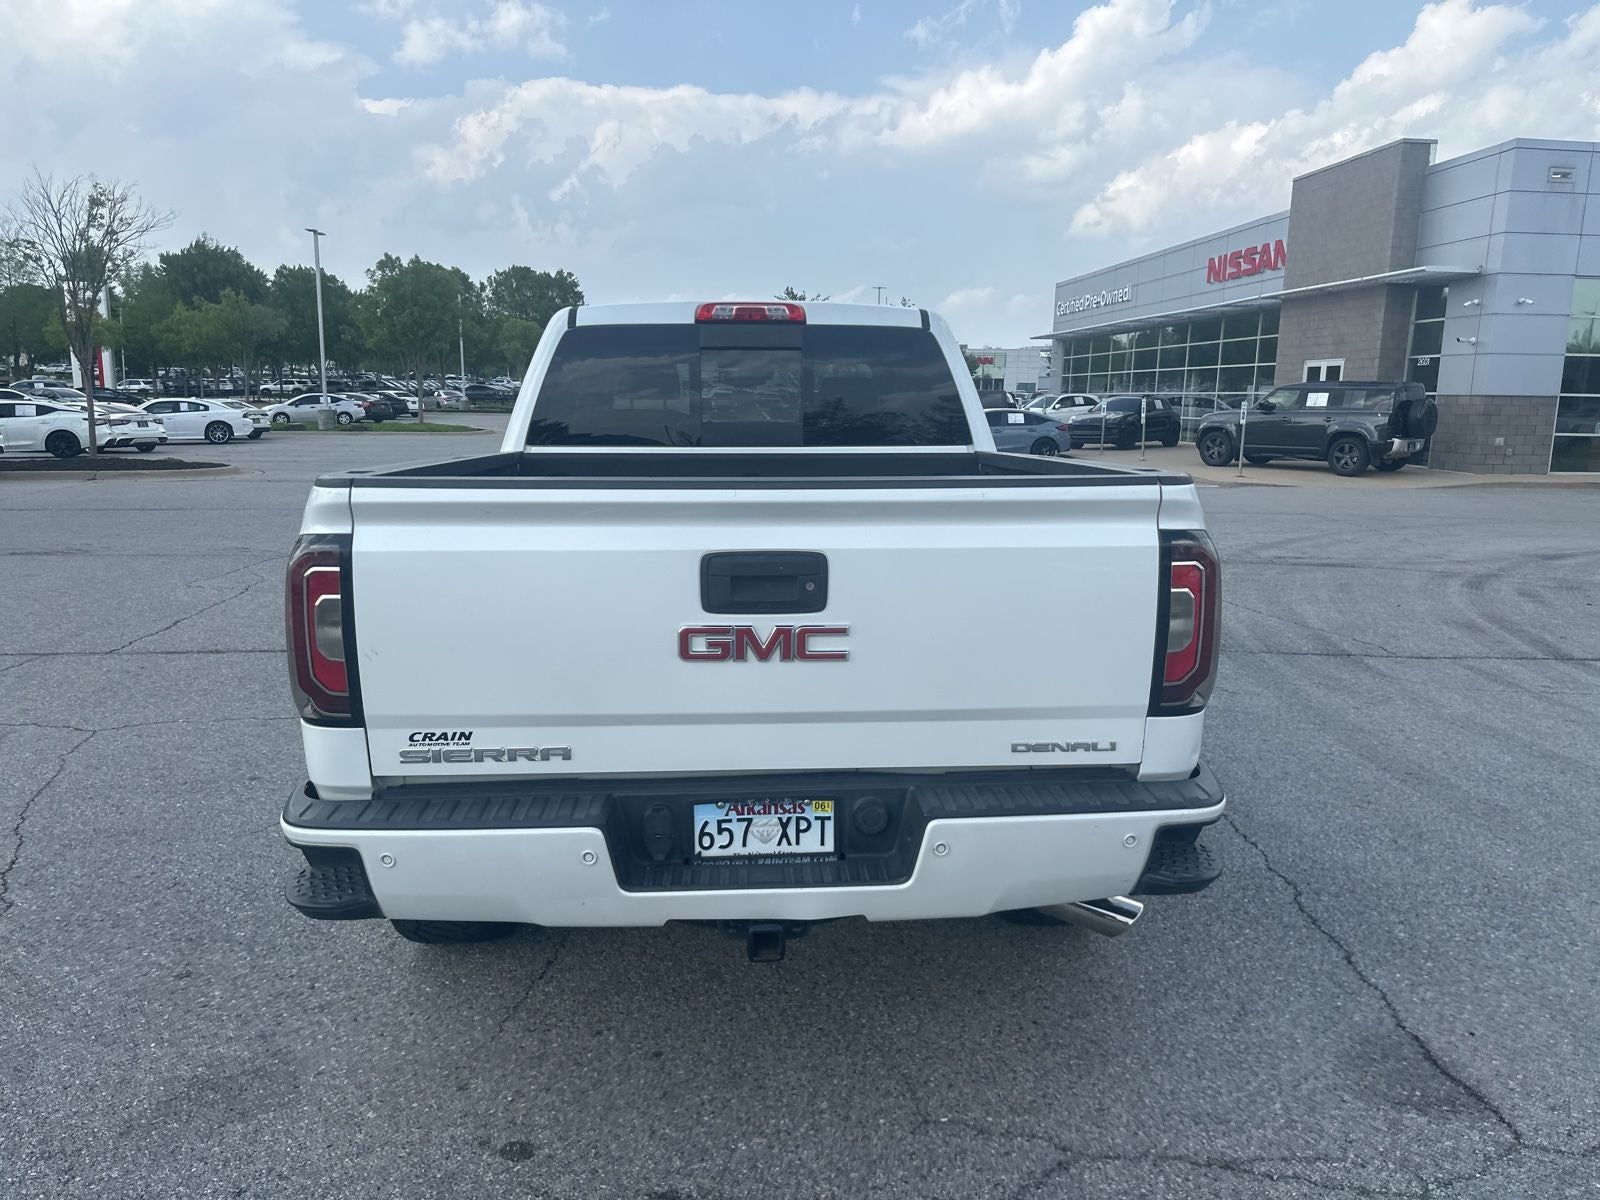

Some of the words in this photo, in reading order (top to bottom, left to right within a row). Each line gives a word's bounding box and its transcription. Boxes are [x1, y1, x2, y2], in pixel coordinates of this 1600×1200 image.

[1206, 240, 1287, 284] NISSAN
[1056, 296, 1084, 316] Certified
[1084, 283, 1131, 310] Pre-Owned
[678, 624, 850, 662] GMC
[408, 731, 473, 742] CRAIN
[1010, 741, 1117, 753] DENALI
[399, 745, 572, 764] SIERRA
[725, 800, 806, 816] Arkansas
[698, 818, 753, 850] 657
[776, 816, 831, 846] XPT
